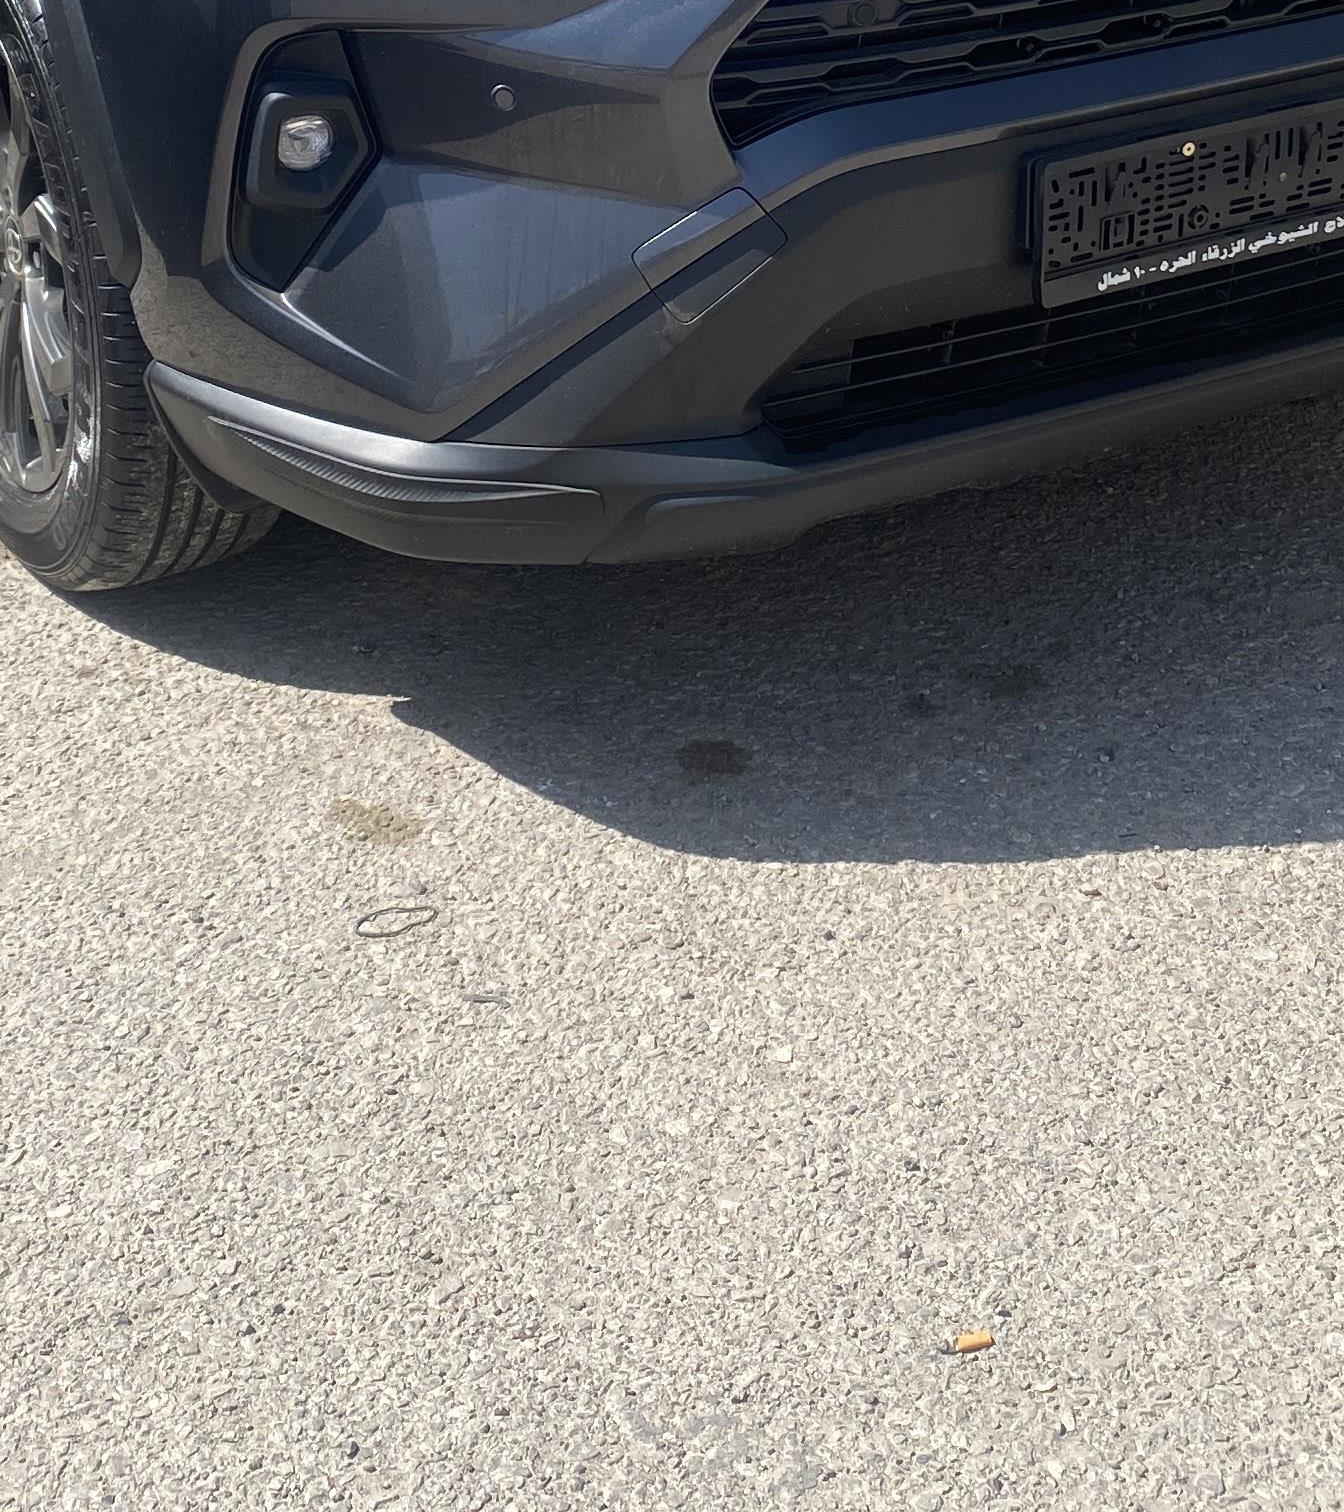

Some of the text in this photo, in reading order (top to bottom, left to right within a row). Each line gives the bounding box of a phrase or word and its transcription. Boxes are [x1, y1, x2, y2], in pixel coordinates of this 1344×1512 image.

[1201, 238, 1246, 262] الزرقاء
[1248, 221, 1319, 254] الشيوخي
[1097, 267, 1131, 292] شمال
